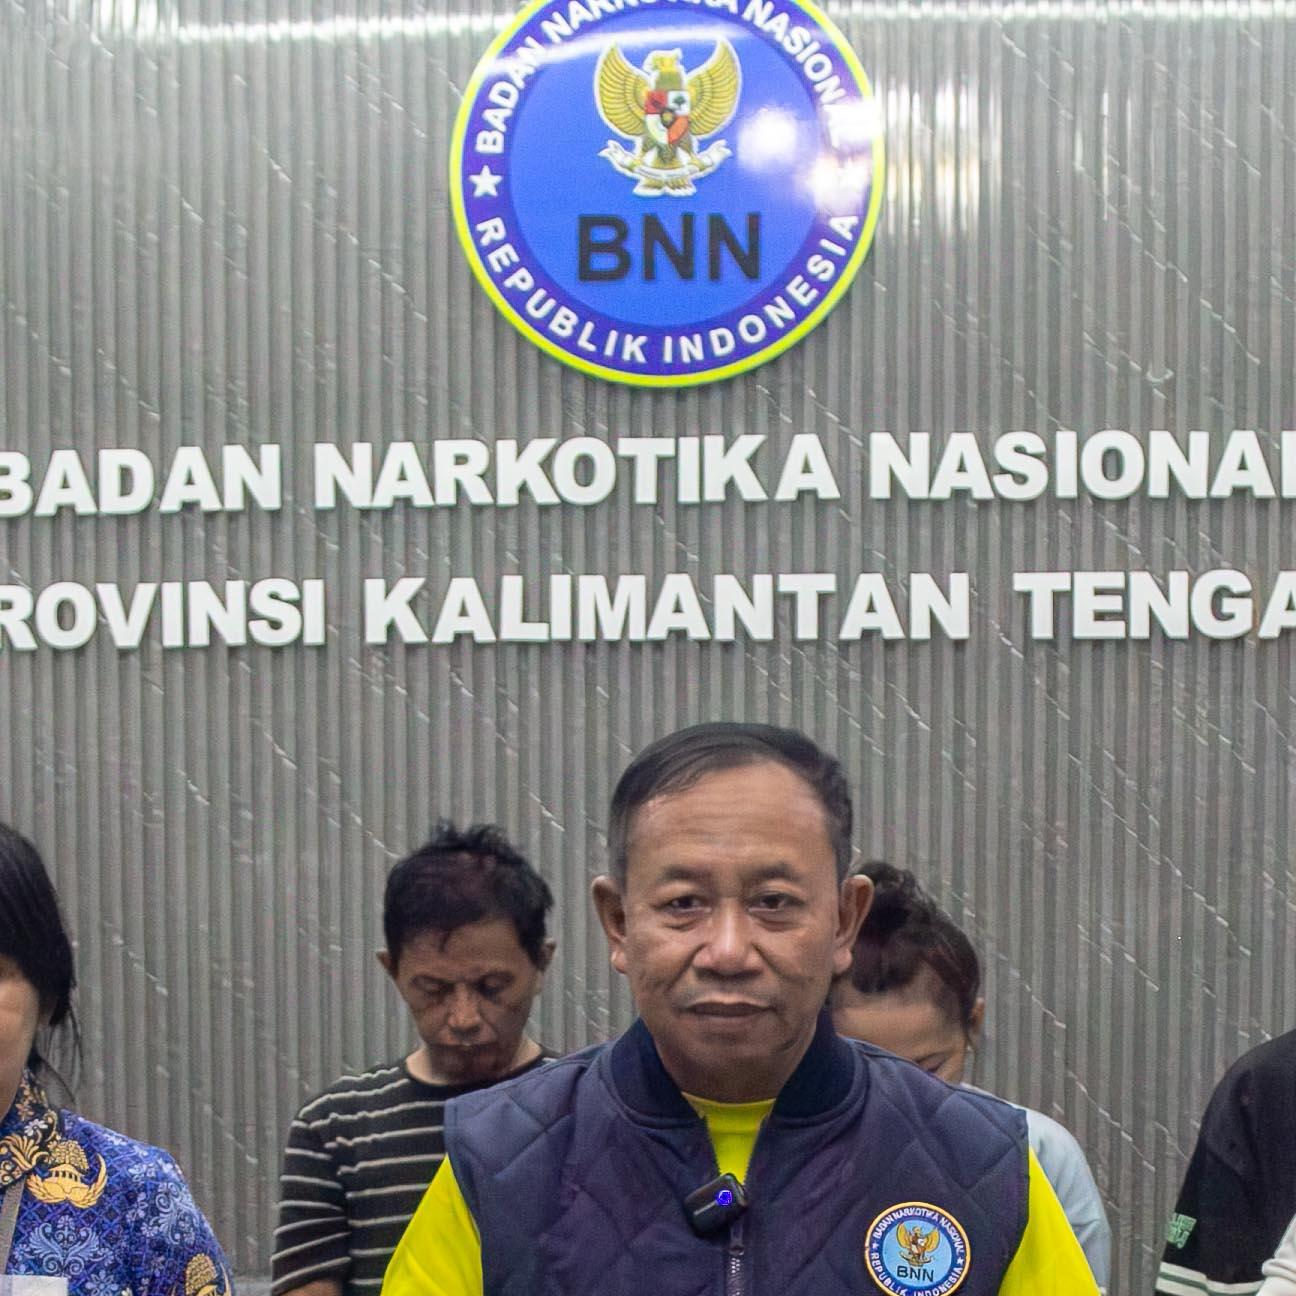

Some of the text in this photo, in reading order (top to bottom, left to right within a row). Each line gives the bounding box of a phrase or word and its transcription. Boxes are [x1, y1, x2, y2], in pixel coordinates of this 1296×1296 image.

[475, 36, 546, 154] BADAN
[577, 213, 762, 282] BNN
[475, 214, 860, 364] REPUBLIK INDONESIA
[314, 435, 841, 510] NARKOTIKA
[364, 572, 970, 645] KALIMANTAN
[896, 1265, 935, 1283] BNN
